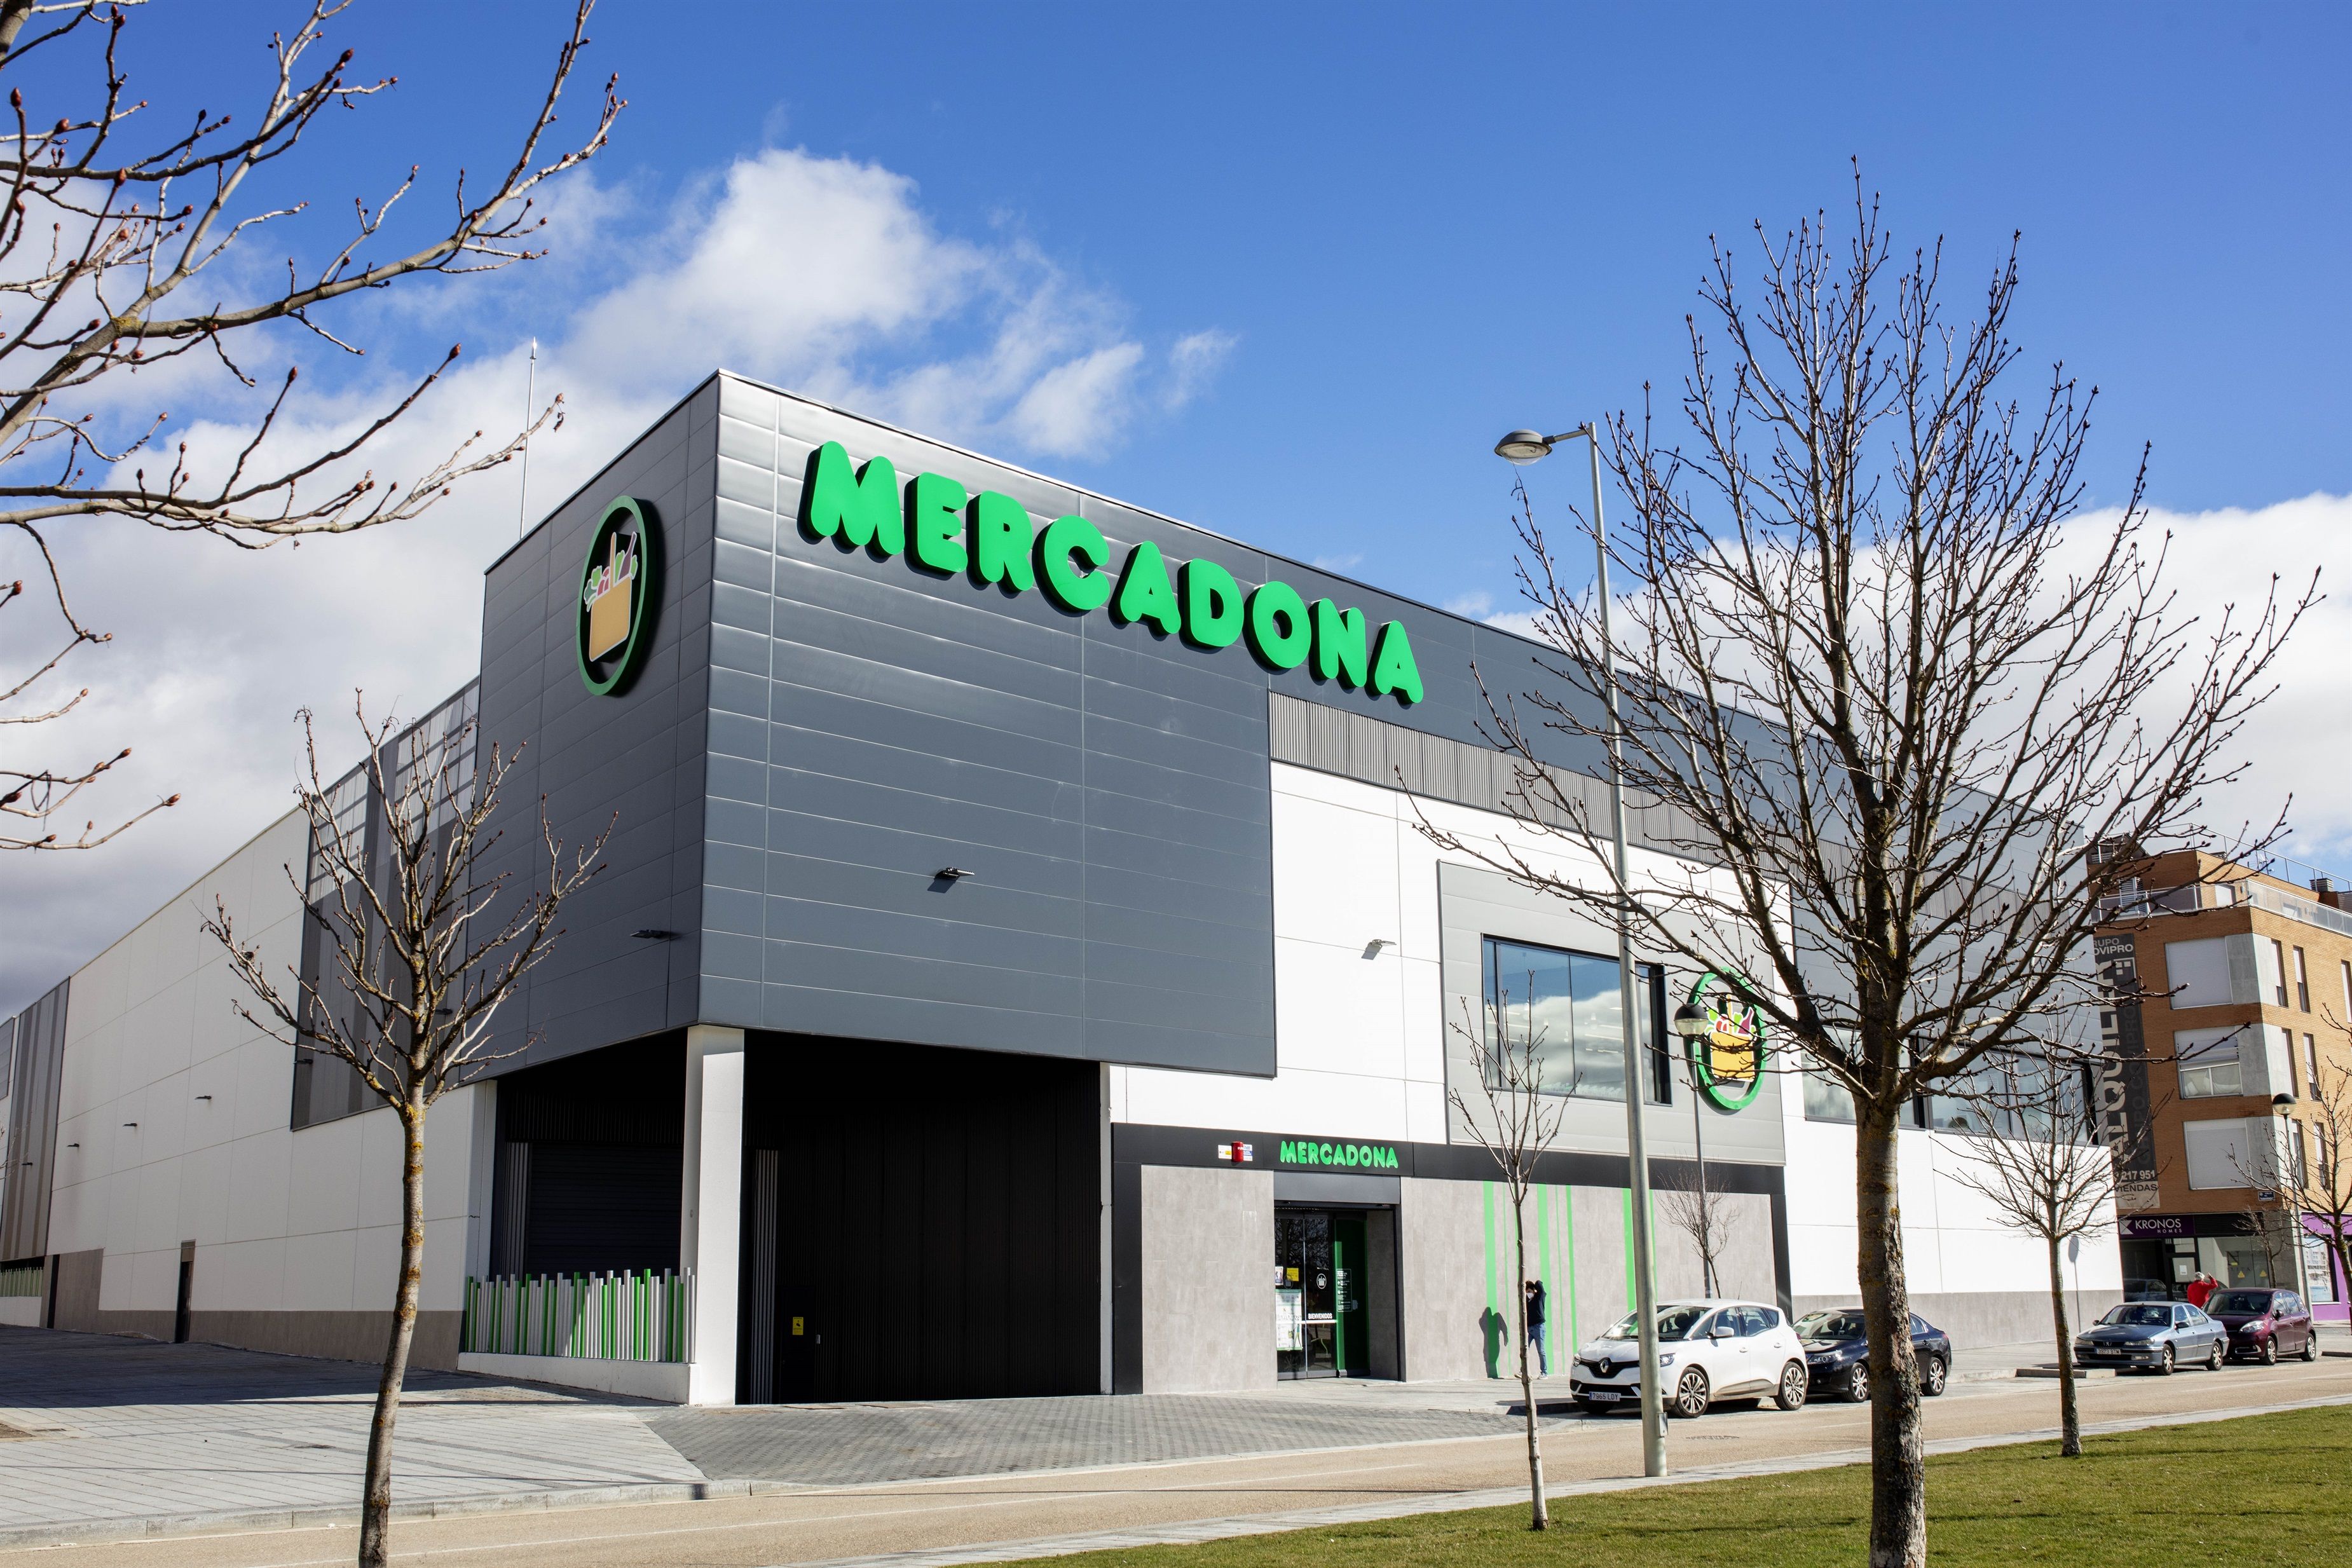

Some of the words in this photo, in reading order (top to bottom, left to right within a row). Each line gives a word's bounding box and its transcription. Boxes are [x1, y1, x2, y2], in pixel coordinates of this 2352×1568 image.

[806, 440, 1425, 705] MERCADONA
[2094, 937, 2120, 947] RUPO
[2094, 944, 2133, 956] OVIPRO
[1280, 1141, 1398, 1168] MERCADONA
[2139, 1169, 2156, 1179] 951
[2135, 1218, 2182, 1229] KRONOS
